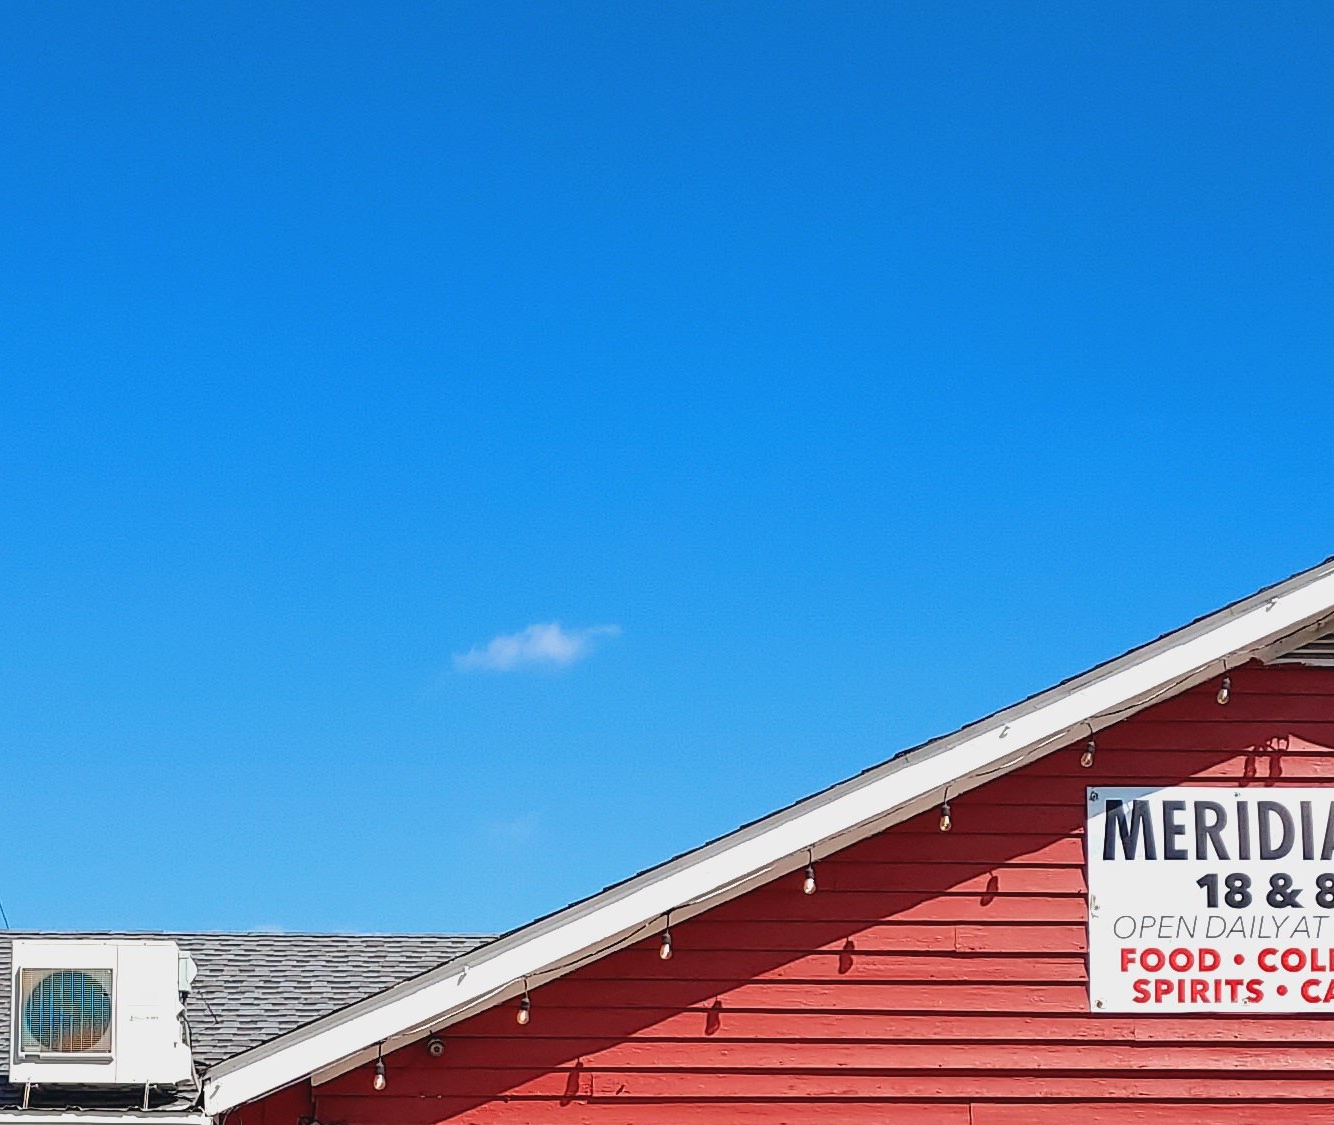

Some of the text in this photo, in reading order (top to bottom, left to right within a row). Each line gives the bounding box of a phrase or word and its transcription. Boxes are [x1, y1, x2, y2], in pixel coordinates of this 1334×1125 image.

[1196, 873, 1252, 909] 18
[1267, 873, 1305, 909] &
[1112, 915, 1200, 940] OPEN
[1204, 915, 1290, 940] DAILY
[1287, 915, 1333, 940] AT
[1120, 947, 1222, 973] FOOD
[1132, 978, 1264, 1004] SPIRITS
